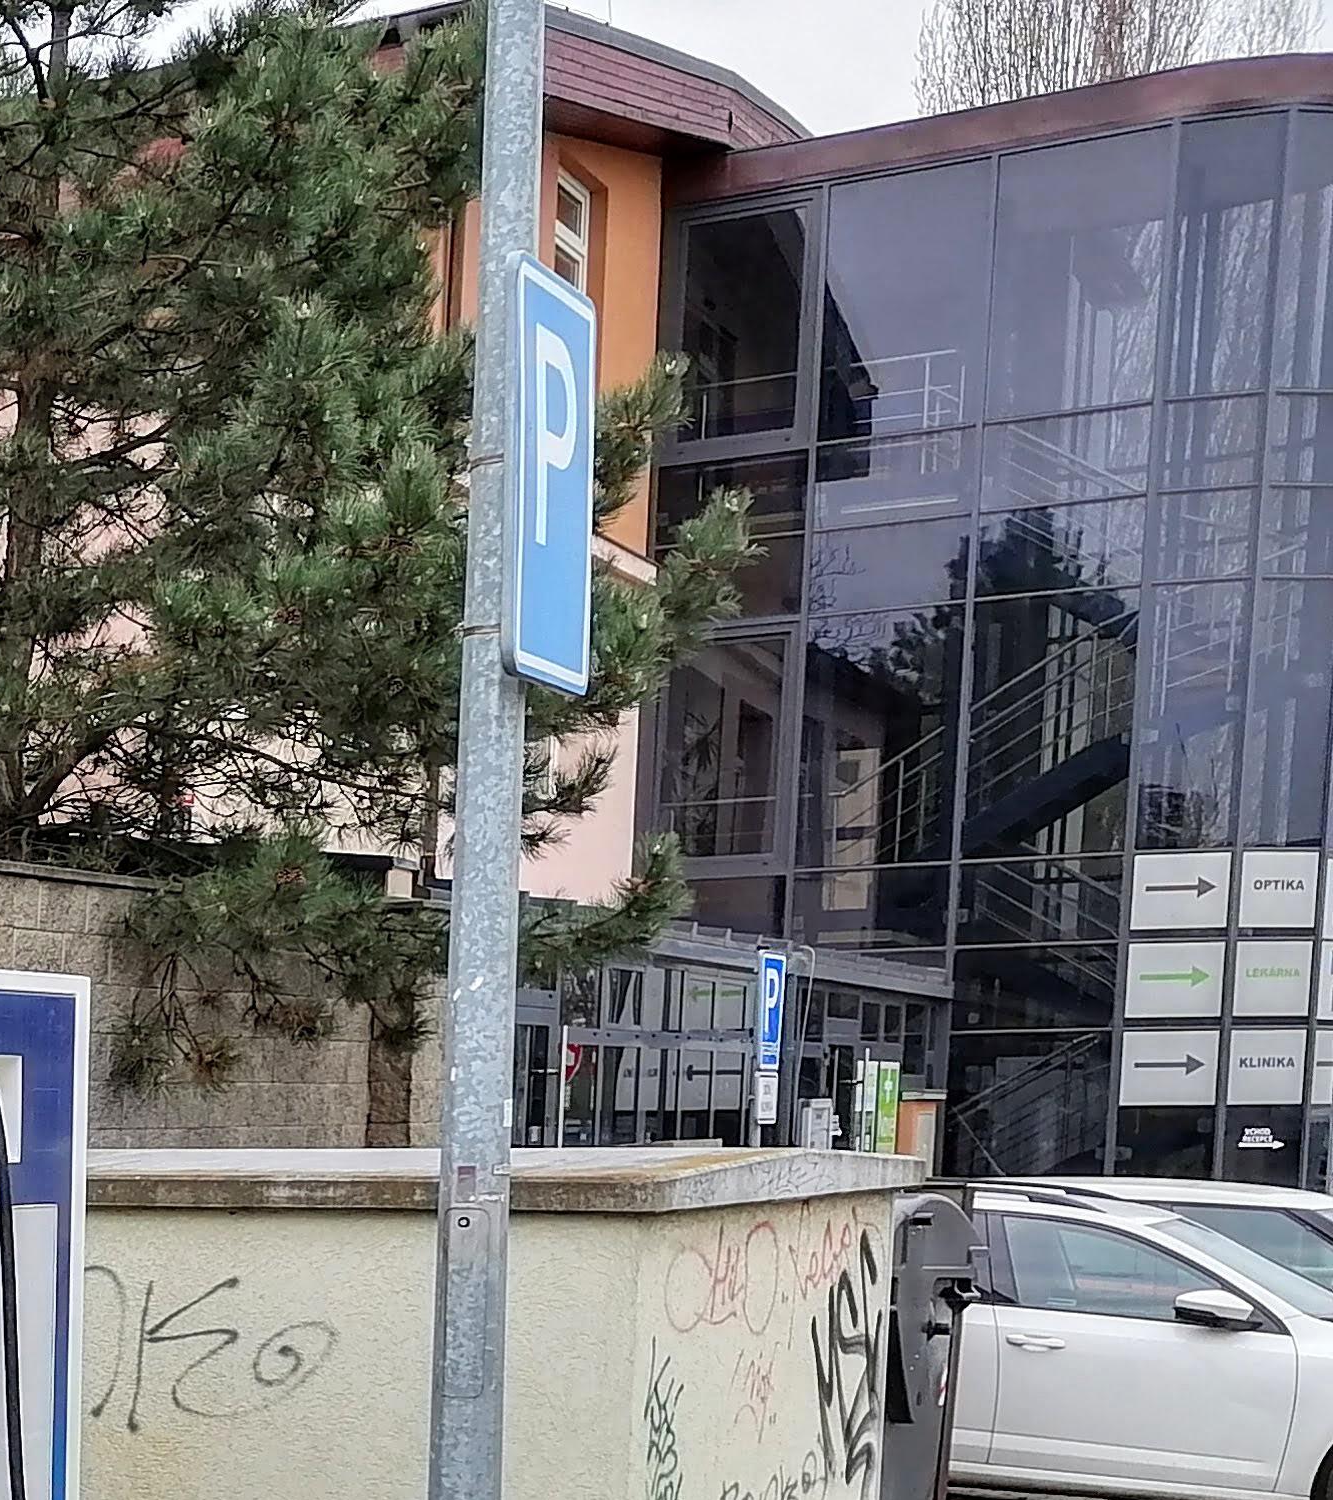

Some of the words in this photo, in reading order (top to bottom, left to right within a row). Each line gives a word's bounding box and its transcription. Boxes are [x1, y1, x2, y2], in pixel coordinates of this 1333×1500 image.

[535, 322, 577, 546] P
[1253, 879, 1305, 892] OPTIKA
[1245, 964, 1301, 980] LEKÁRNA
[764, 967, 780, 1034] P
[1238, 1055, 1296, 1069] KLINIKA
